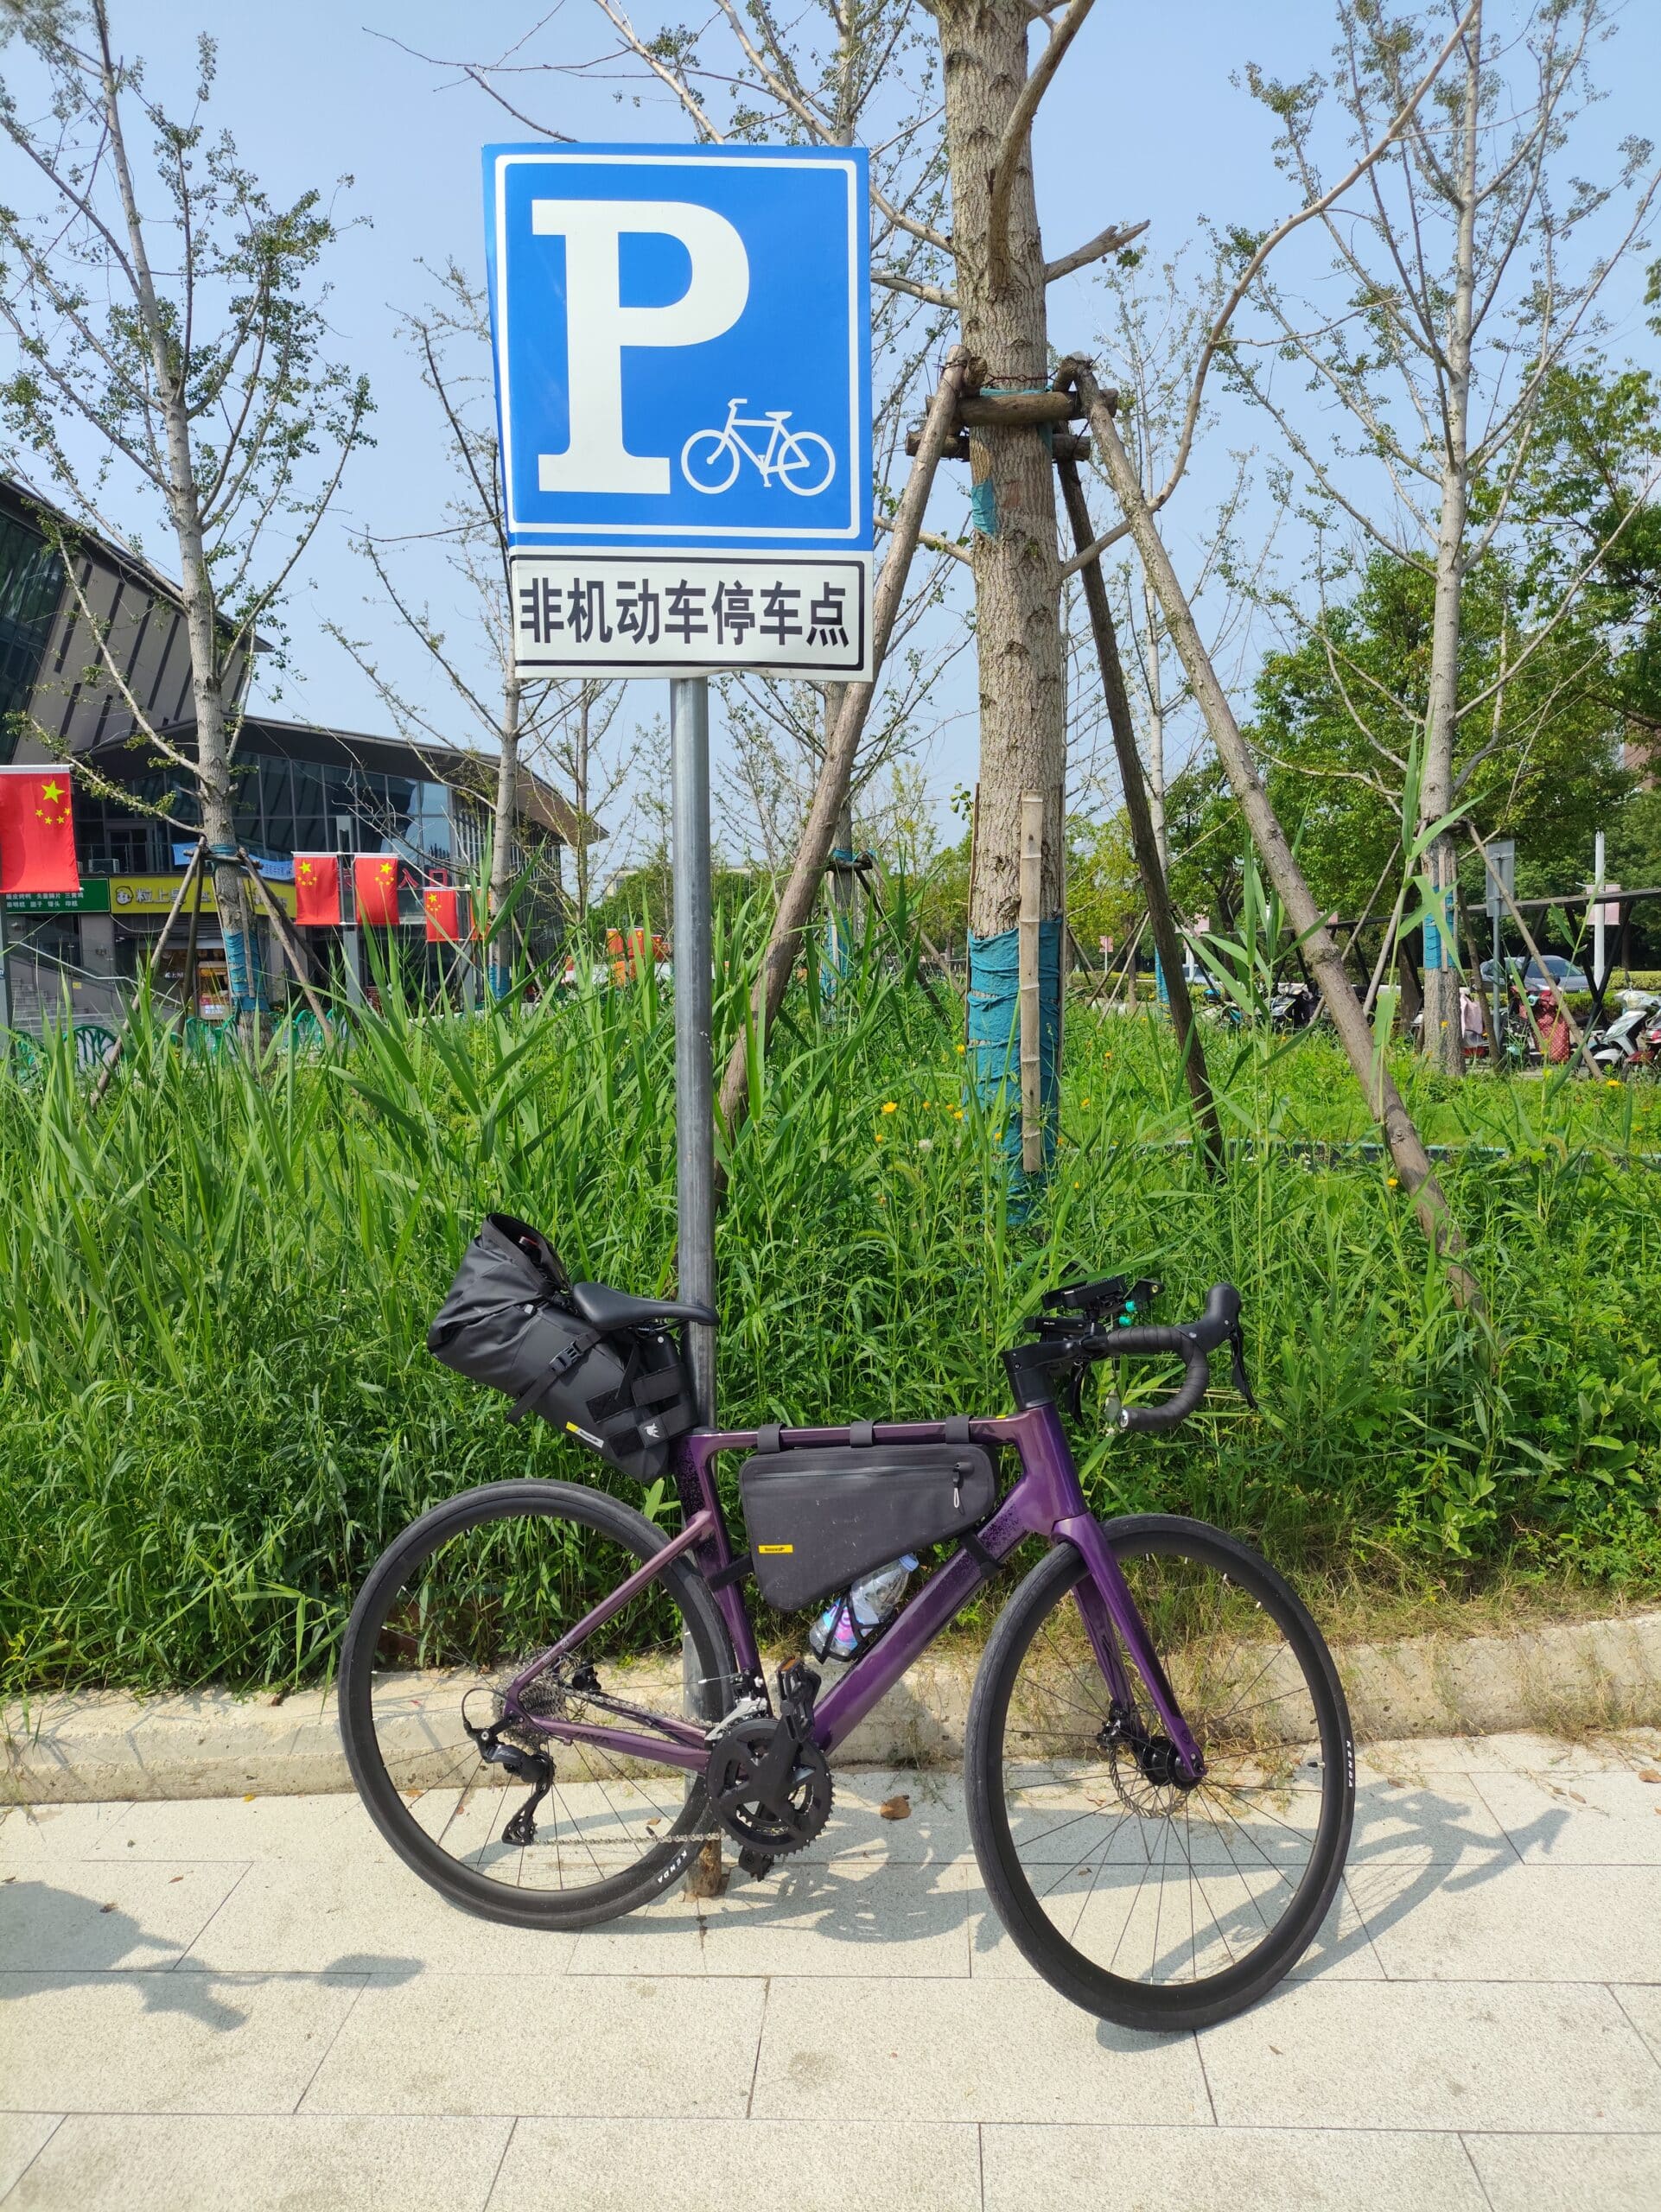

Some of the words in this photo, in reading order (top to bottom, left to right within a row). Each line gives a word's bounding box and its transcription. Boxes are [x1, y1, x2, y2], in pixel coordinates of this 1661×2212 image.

[531, 199, 750, 495] P
[519, 576, 850, 649] 非机动车停车点
[657, 1849, 688, 1884] KENDA
